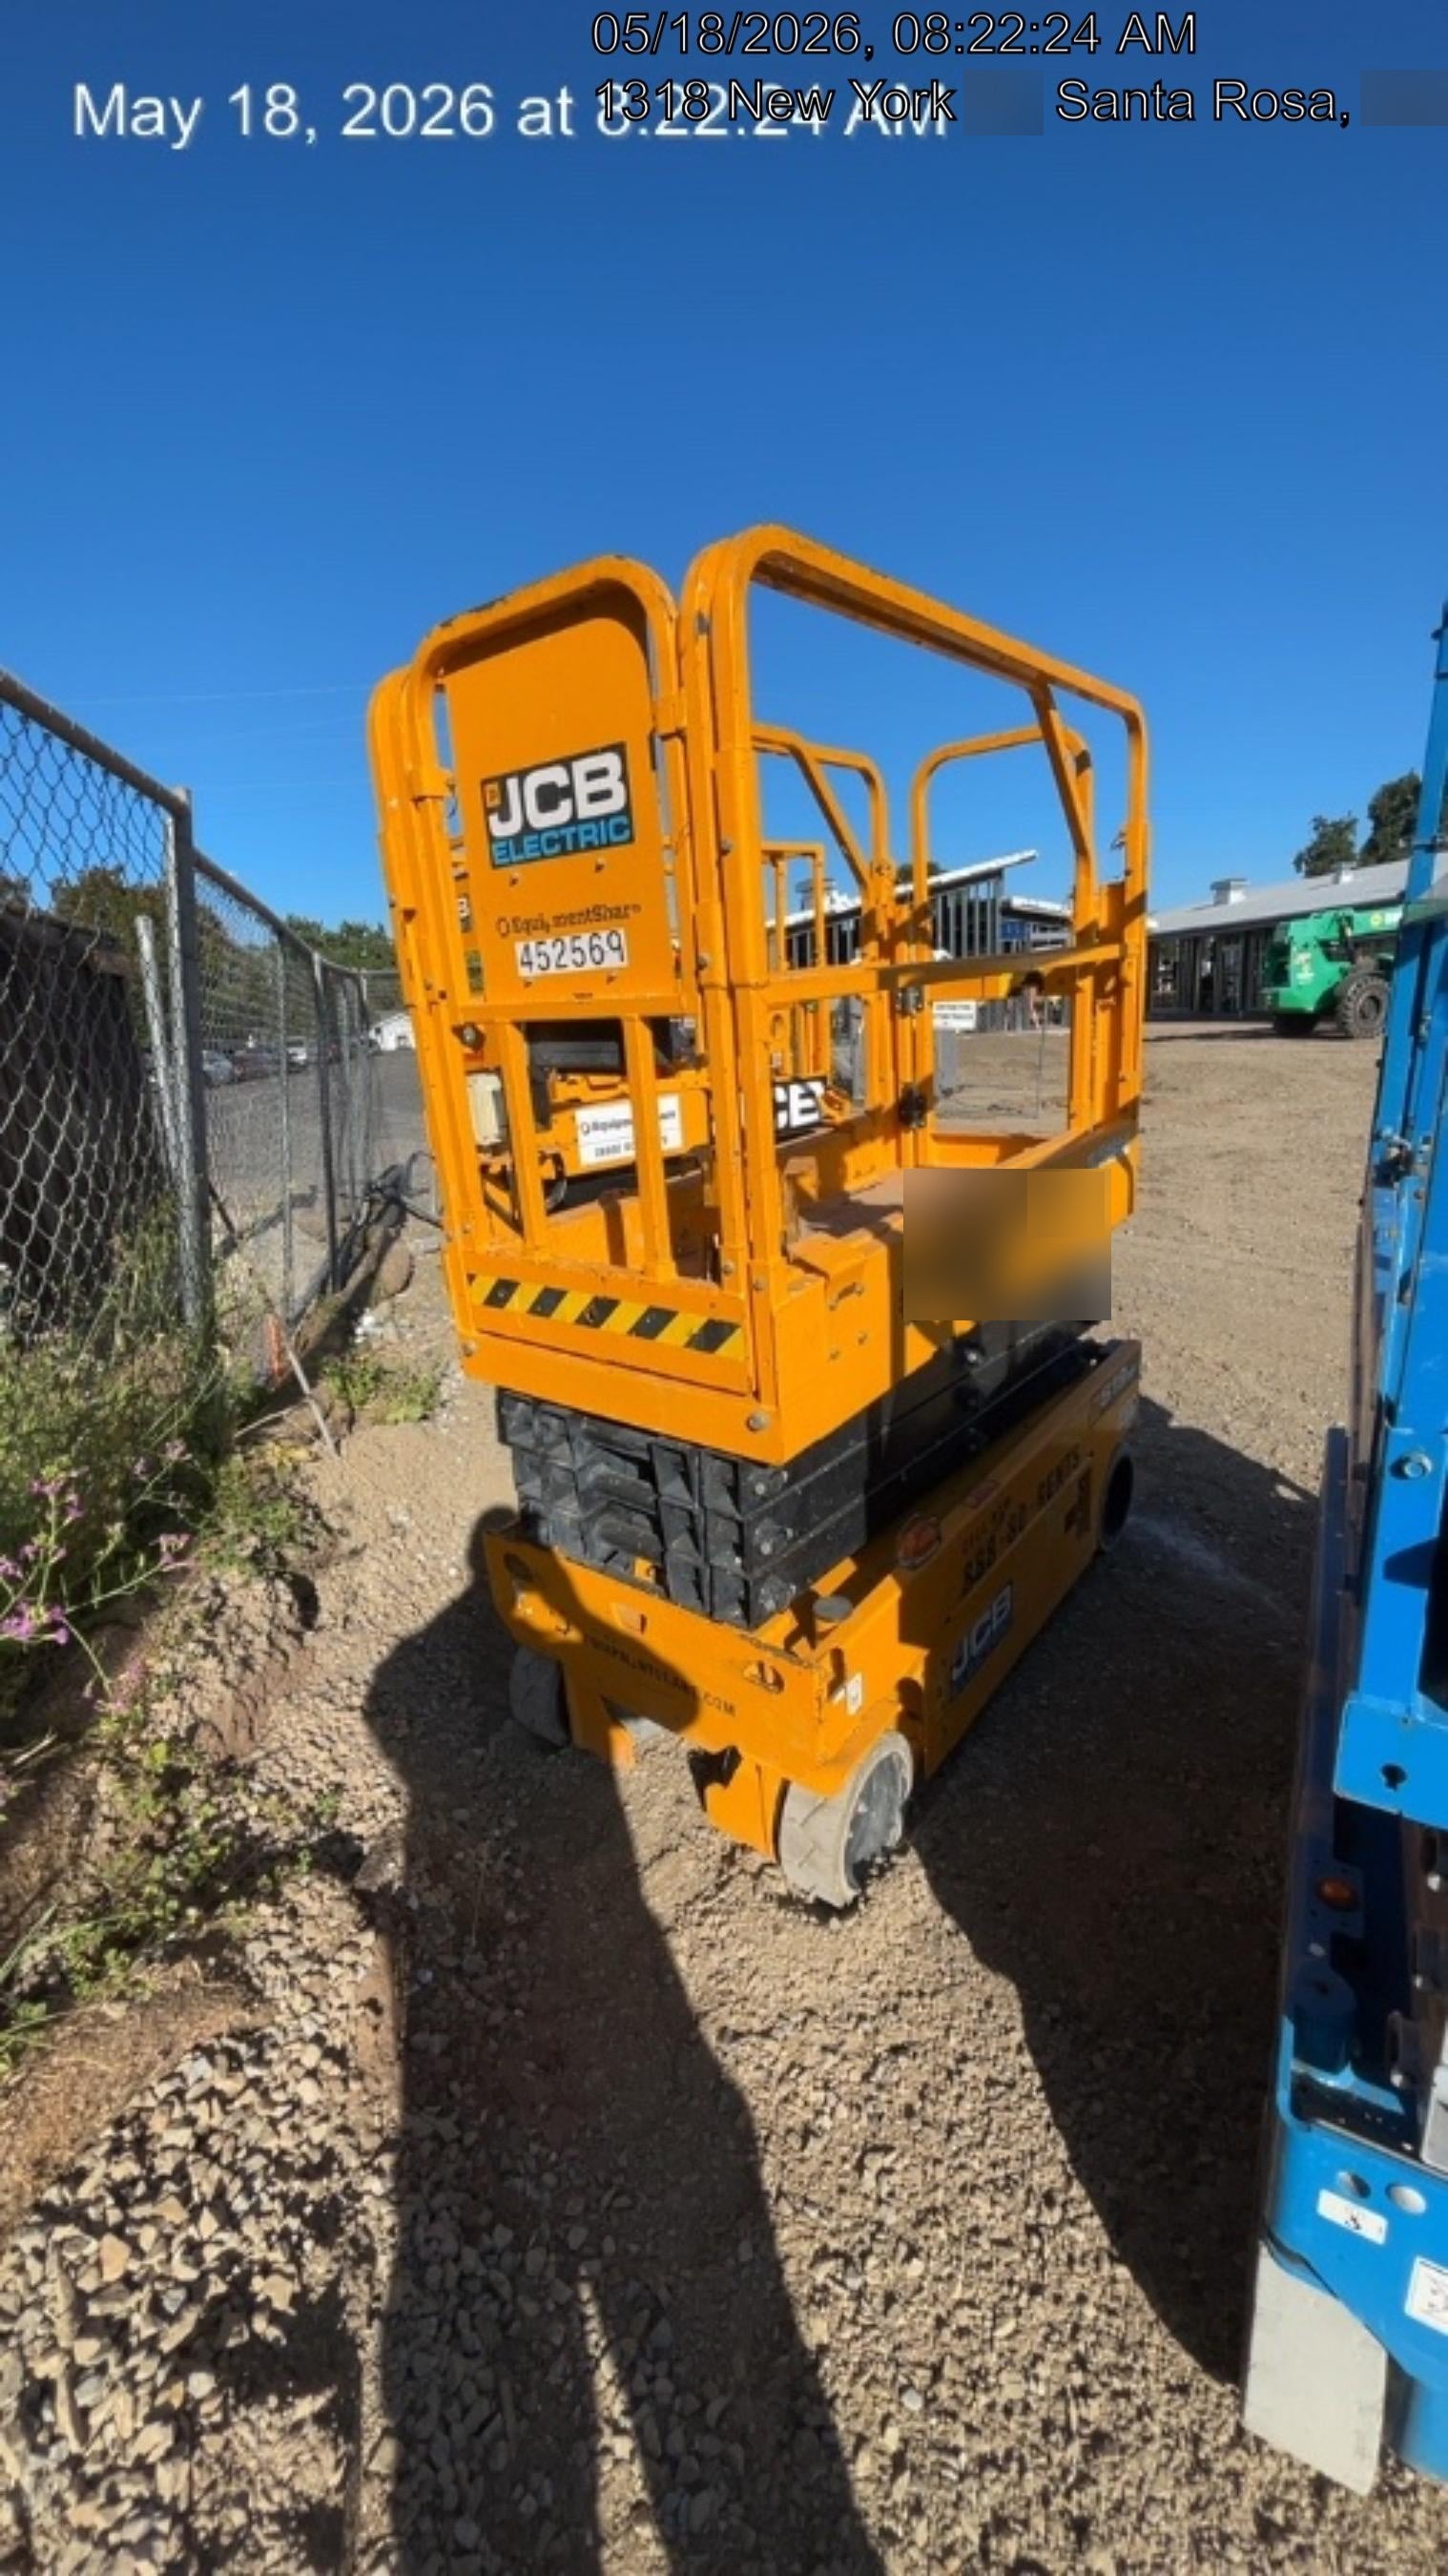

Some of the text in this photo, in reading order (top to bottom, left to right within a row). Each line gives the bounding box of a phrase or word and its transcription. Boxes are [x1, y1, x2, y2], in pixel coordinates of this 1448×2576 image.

[487, 750, 628, 838] JCB
[491, 814, 631, 866] ELECTRIC
[520, 929, 625, 973] 452569
[952, 1583, 1013, 1682] JCB
